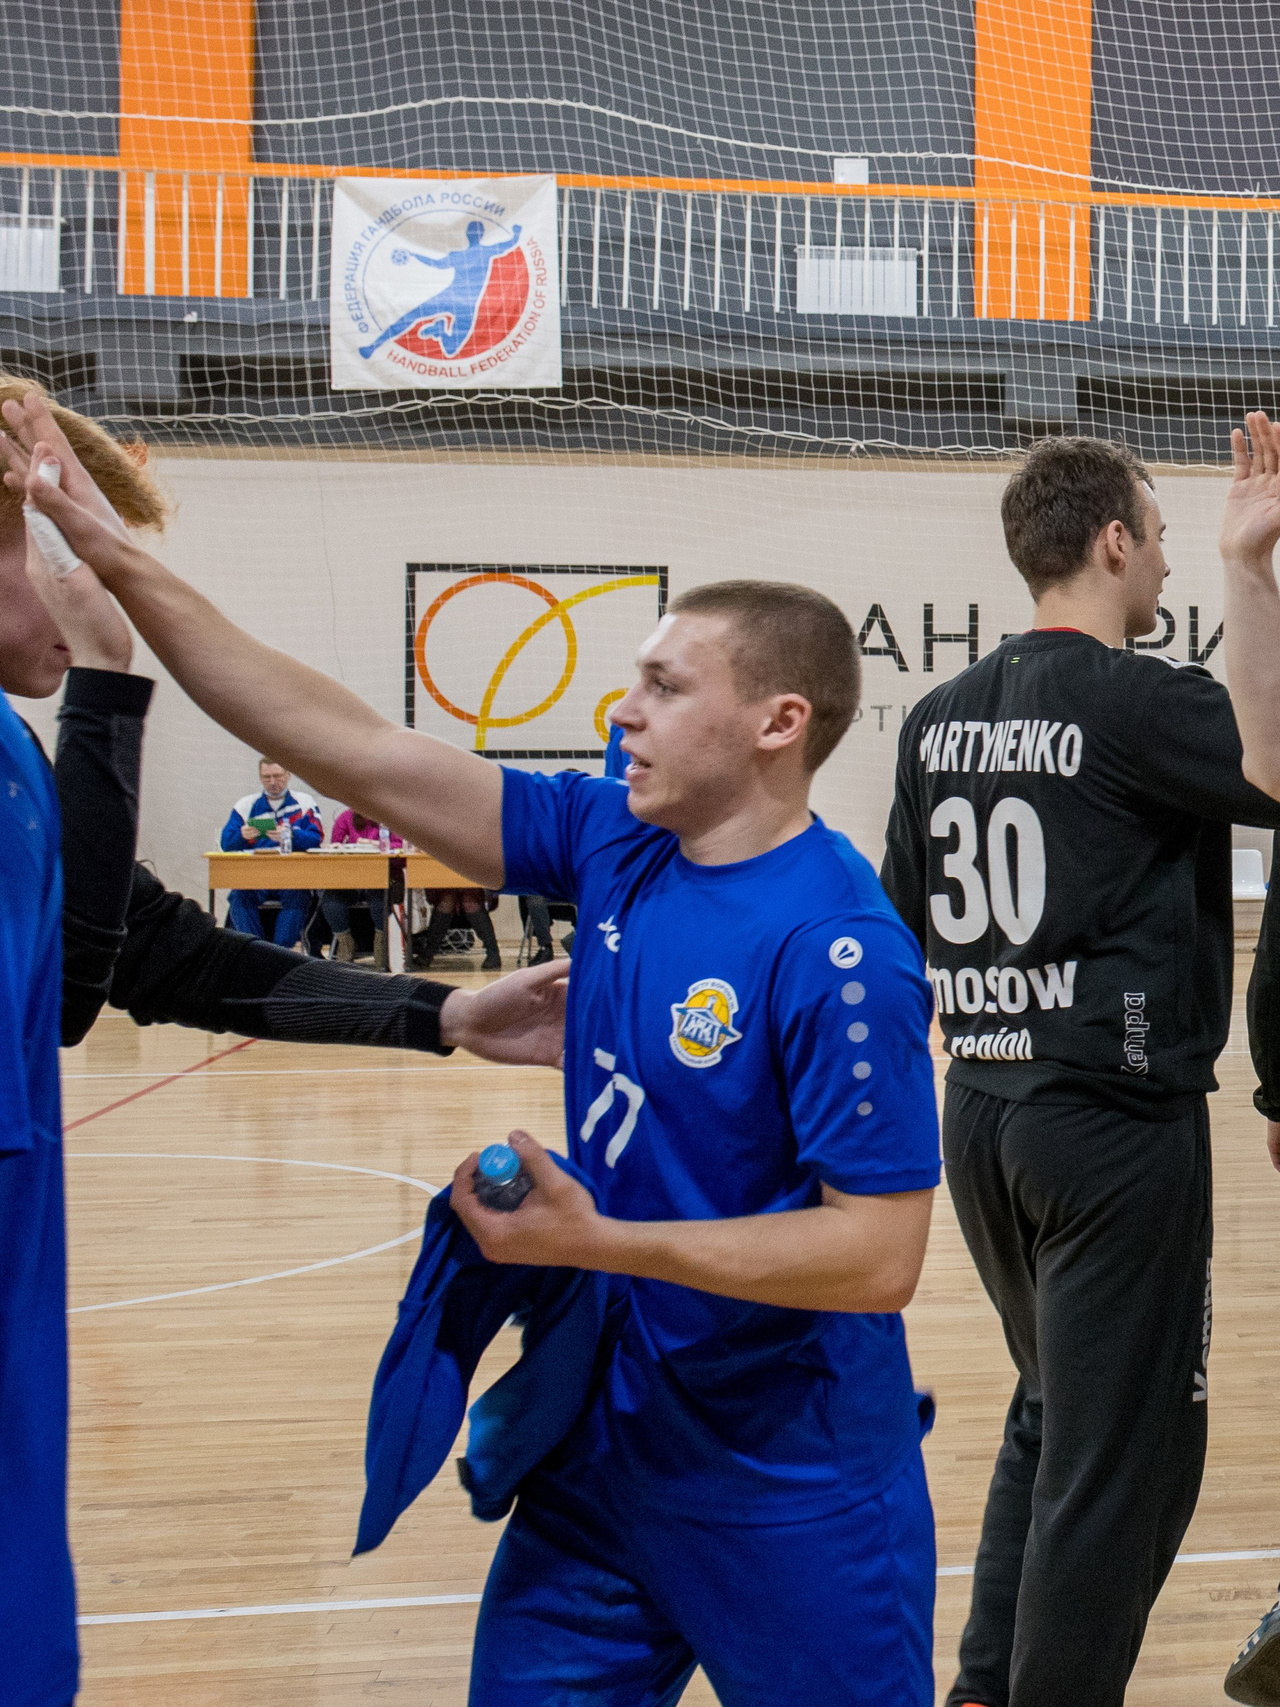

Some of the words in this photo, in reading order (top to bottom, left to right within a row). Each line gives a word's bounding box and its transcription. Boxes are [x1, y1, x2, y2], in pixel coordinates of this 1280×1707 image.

[344, 241, 369, 334] ФЕДЕРАЦИЯ
[362, 194, 435, 243] ГАНДБОЛА
[440, 192, 506, 216] РОССИИ
[526, 236, 548, 289] RUSSIA
[533, 290, 546, 309] OF
[386, 349, 468, 378] HANDBALL
[470, 310, 541, 375] FEDERATION
[930, 796, 1046, 945] 30
